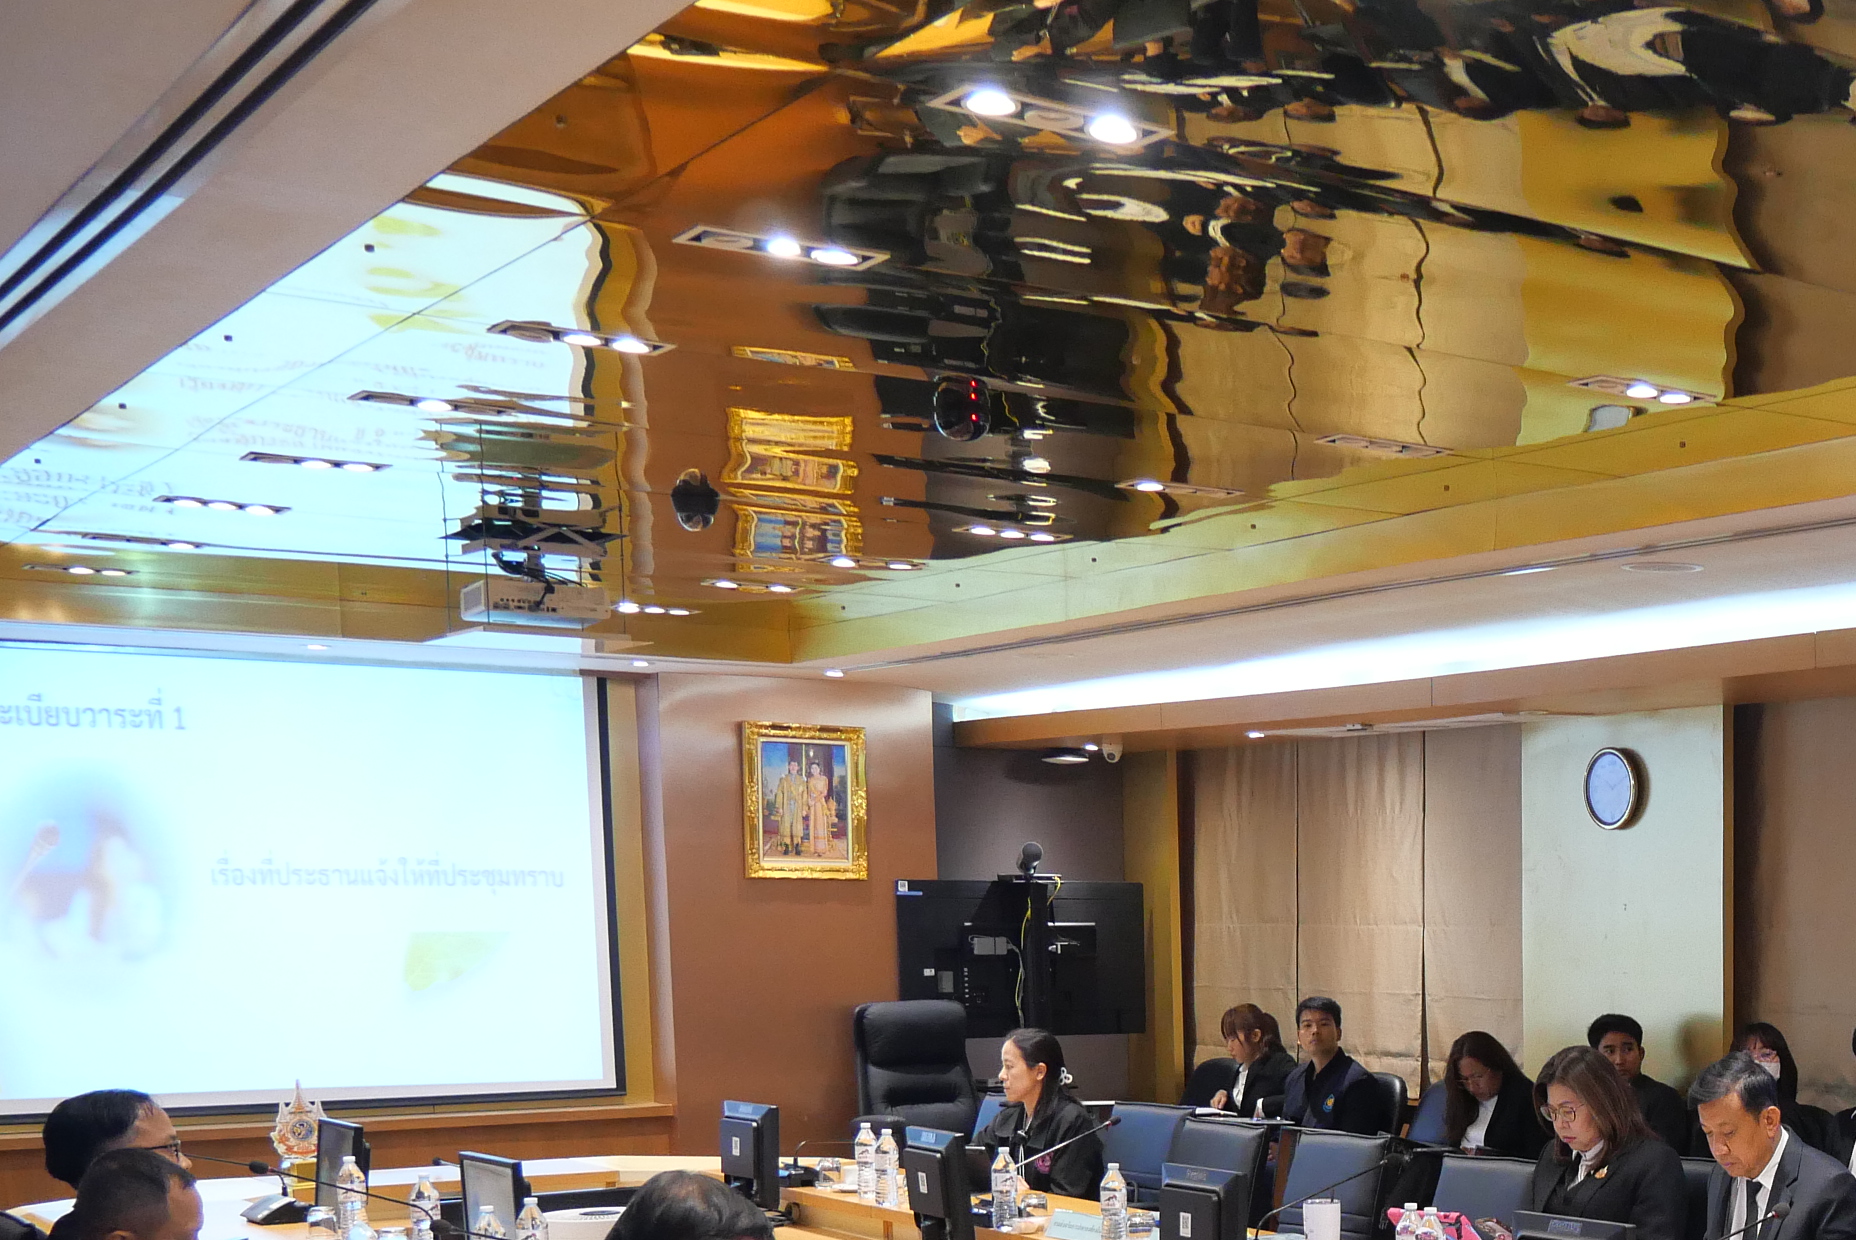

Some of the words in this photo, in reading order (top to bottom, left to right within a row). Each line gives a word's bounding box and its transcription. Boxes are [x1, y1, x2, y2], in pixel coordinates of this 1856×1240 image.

[173, 706, 186, 730] 1
[210, 851, 565, 895] เรื่องที่ประธานแจ้งให้ที่ประชุมทราบ
